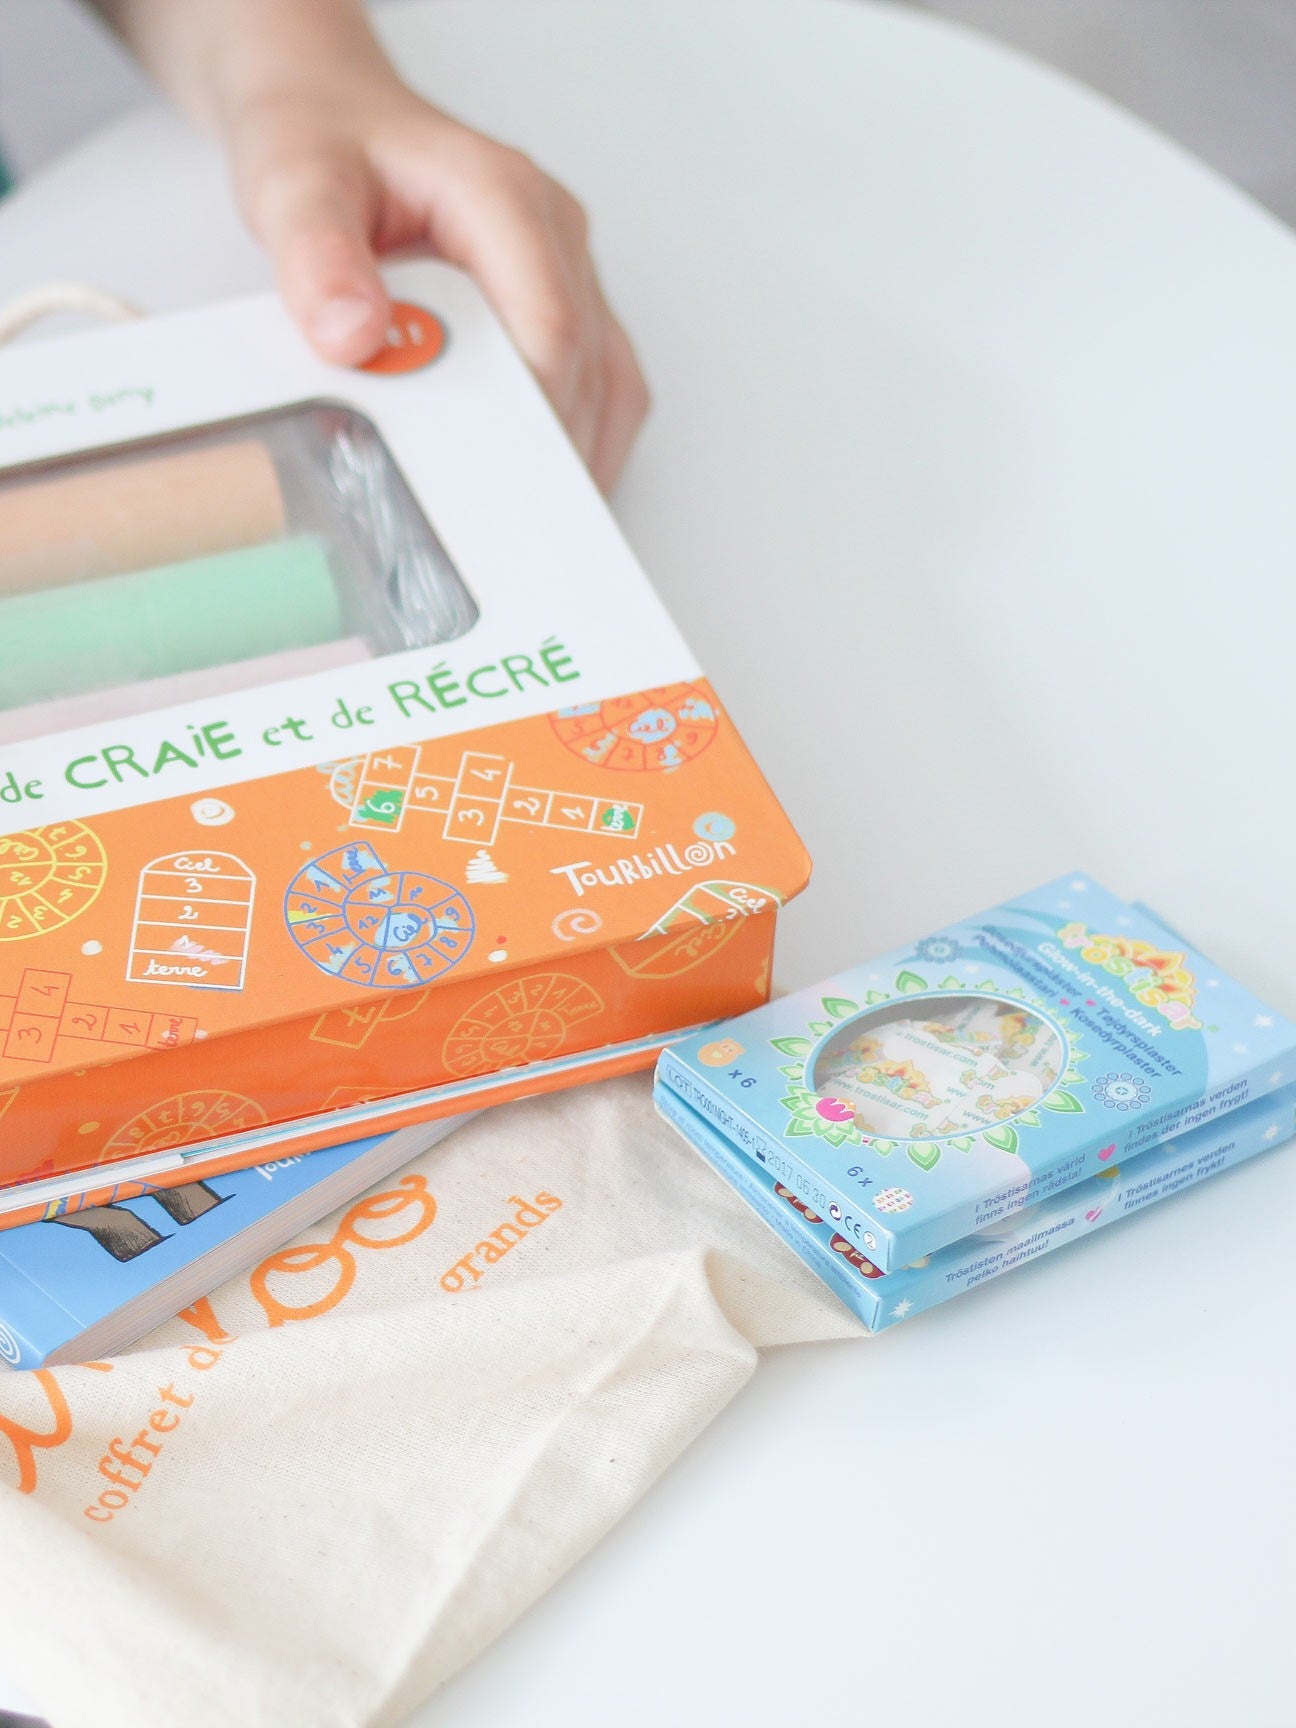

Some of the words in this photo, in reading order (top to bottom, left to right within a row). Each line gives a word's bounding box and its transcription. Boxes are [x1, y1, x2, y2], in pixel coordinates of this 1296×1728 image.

[0, 771, 44, 803] de
[261, 715, 314, 746] et
[330, 698, 376, 729] de
[388, 635, 581, 718] RÉCRÉ
[173, 857, 221, 873] Ciel
[185, 877, 203, 893] 3
[178, 905, 199, 920] 2
[17, 1026, 42, 1044] 3
[1160, 1120, 1181, 1137] der
[1184, 1104, 1217, 1127] ingen
[1162, 1171, 1194, 1195] ingen
[975, 1208, 1005, 1226] finns
[1007, 1189, 1040, 1213] ingen
[83, 1381, 196, 1523] coffret
